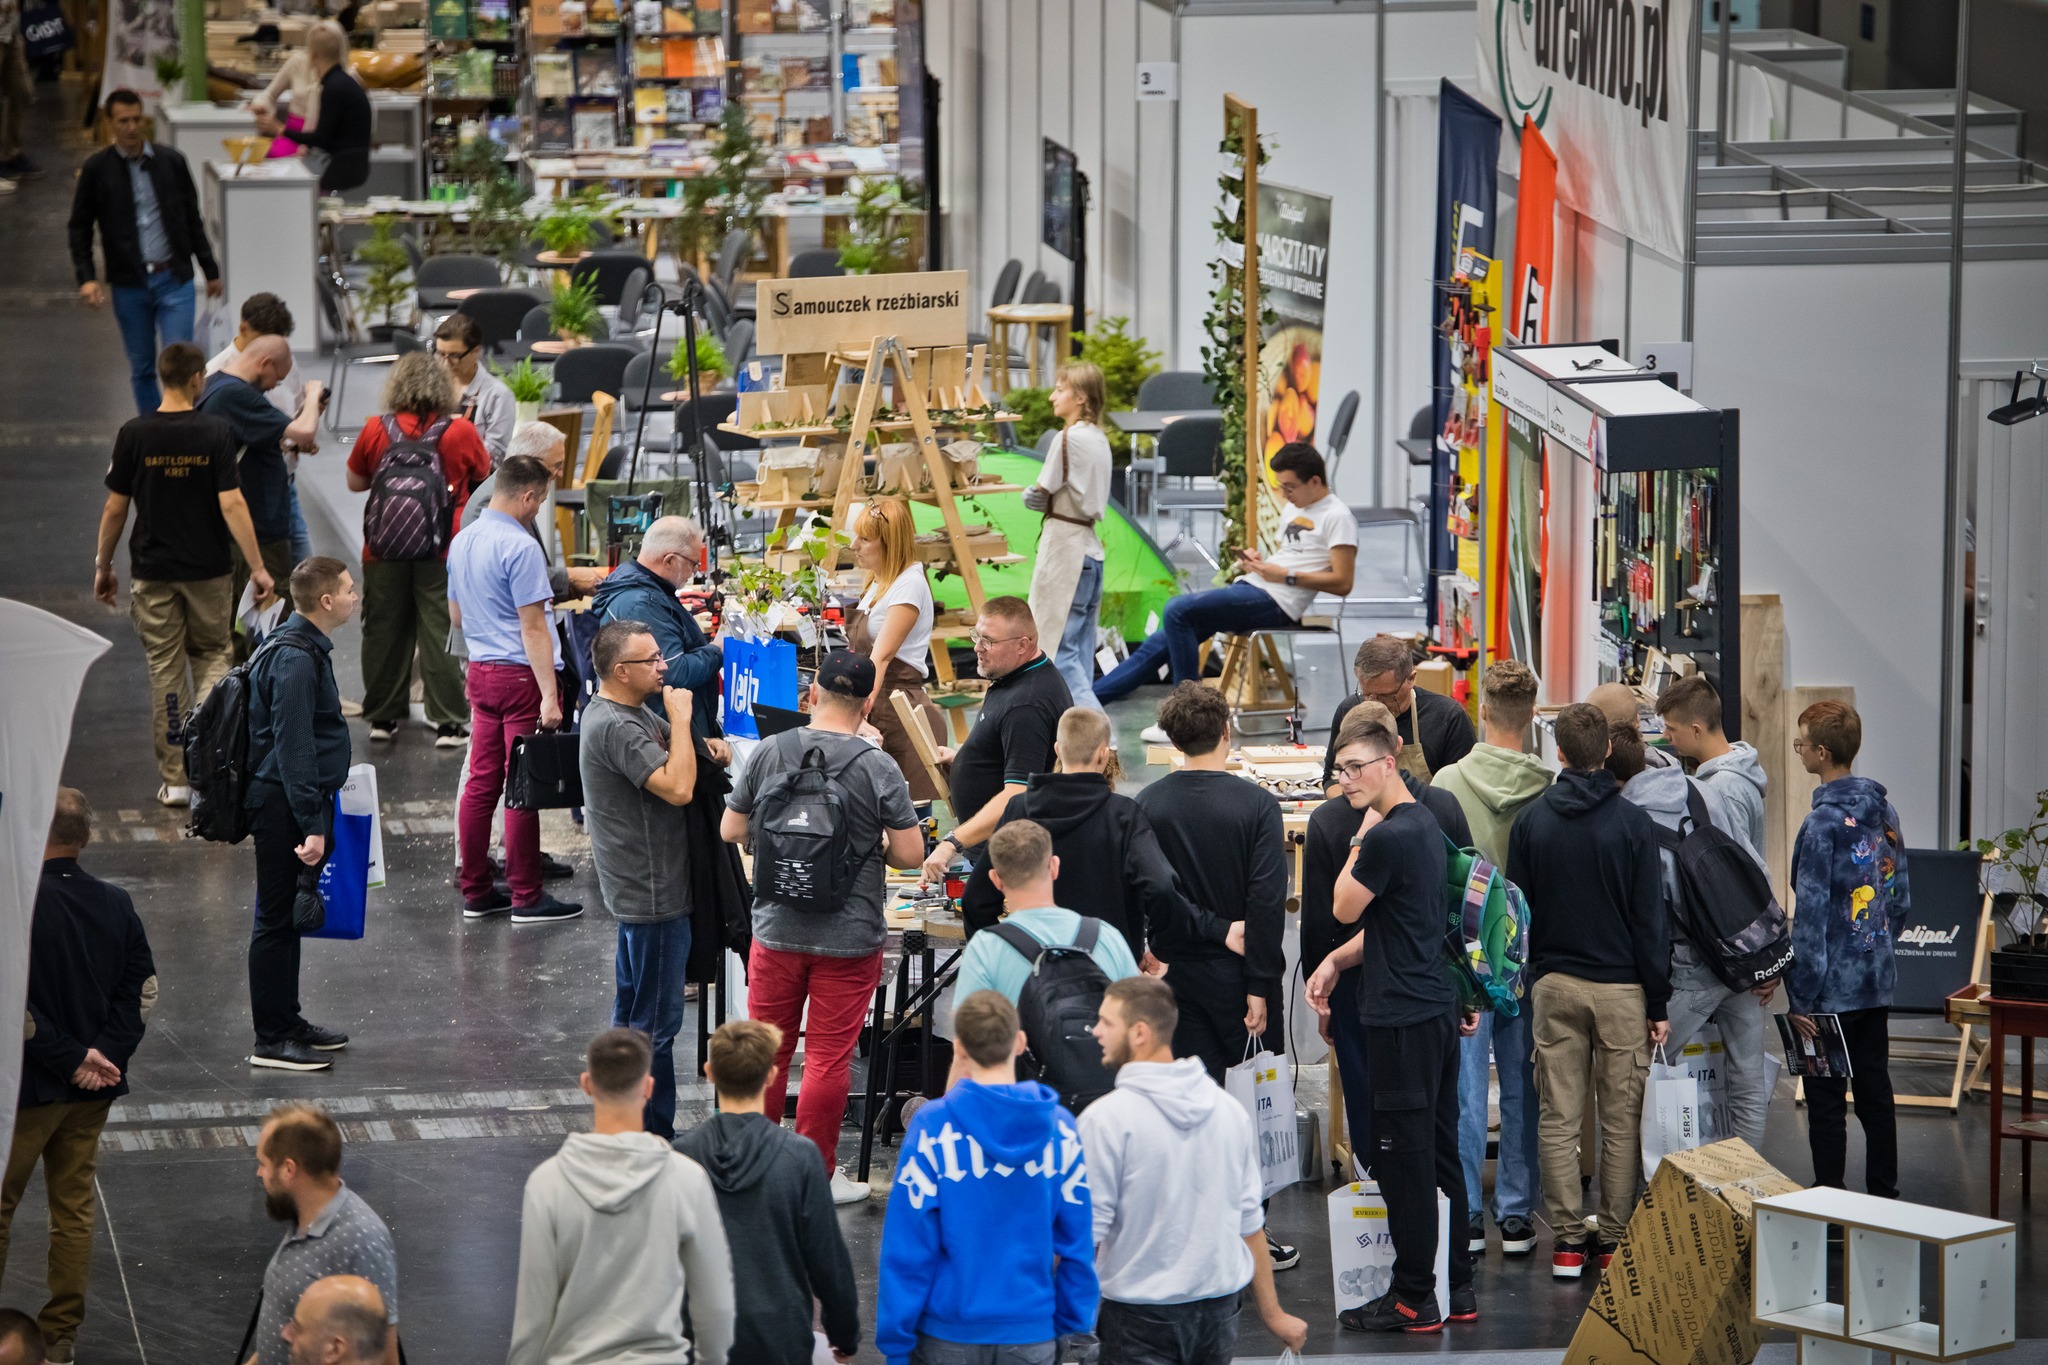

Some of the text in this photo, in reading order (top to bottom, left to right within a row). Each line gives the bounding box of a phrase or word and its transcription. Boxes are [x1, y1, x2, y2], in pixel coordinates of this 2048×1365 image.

[1141, 72, 1151, 85] 3
[774, 290, 959, 316] Samouczek rzeźbiarski
[1645, 354, 1657, 370] 3
[1698, 1068, 1716, 1081] ITA
[1258, 1096, 1272, 1111] ITA
[1376, 1232, 1393, 1245] IT
[1661, 1210, 1676, 1255] matratze
[1689, 1212, 1707, 1266] matratze
[1672, 1308, 1688, 1350] materace
